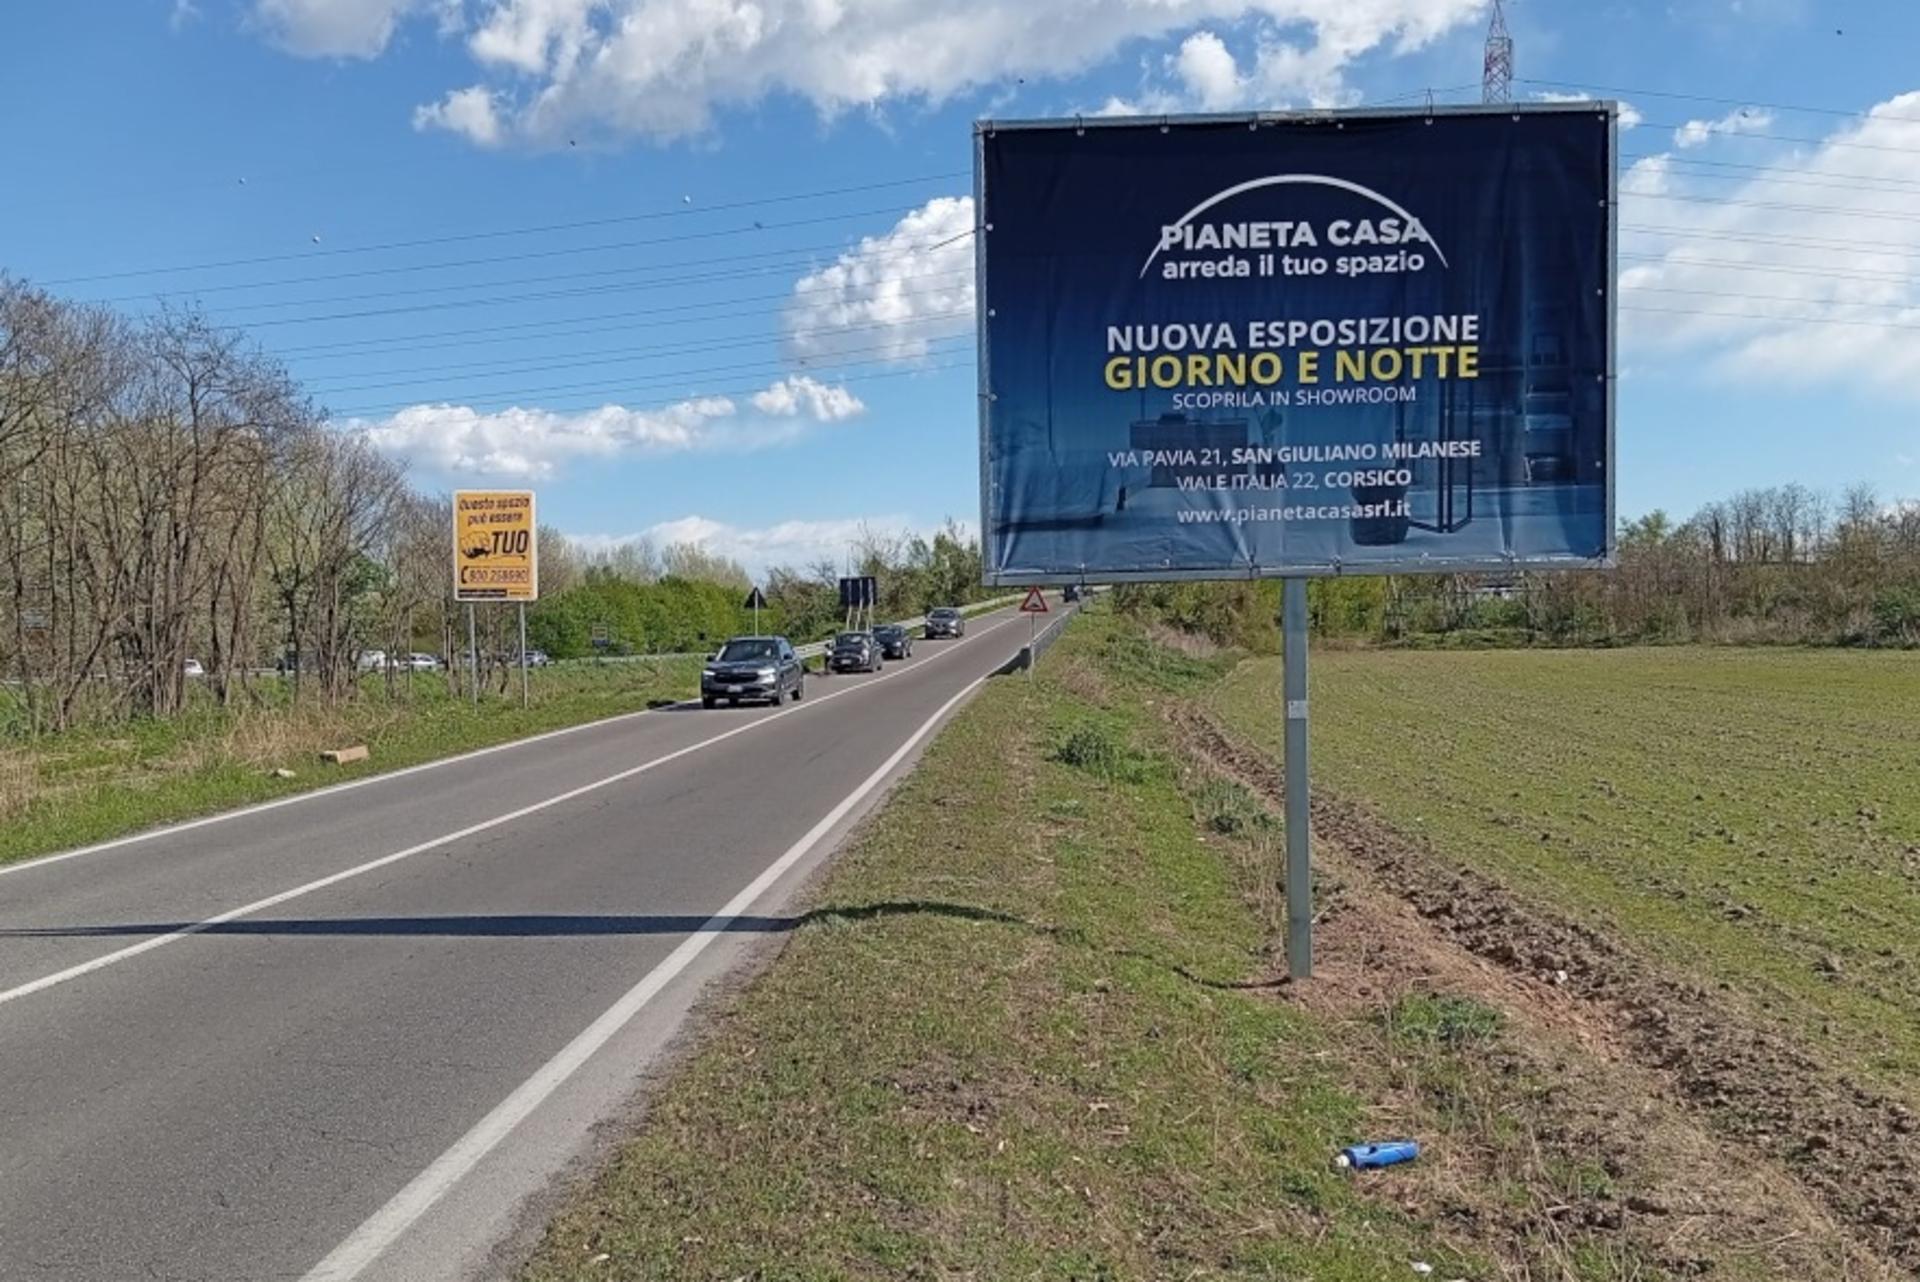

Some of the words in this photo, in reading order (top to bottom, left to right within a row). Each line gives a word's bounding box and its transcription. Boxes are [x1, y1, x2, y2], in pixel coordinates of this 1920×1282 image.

[1160, 221, 1318, 251] PIANETA
[1327, 217, 1430, 247] CASA
[1162, 255, 1250, 280] arreda
[1259, 254, 1274, 277] il
[1282, 255, 1328, 276] tuo
[1335, 250, 1425, 278] spazio
[1107, 323, 1238, 353] NUOVA
[1249, 314, 1480, 349] ESPOSIZIONE
[1104, 351, 1283, 390] GIORNO
[1298, 351, 1320, 384] E
[1335, 345, 1480, 382] NOTTE
[1172, 390, 1265, 410] SCOPRILA
[1270, 389, 1290, 407] IN
[1294, 386, 1417, 407] SHOWROOM
[1107, 451, 1140, 468] VIA
[1142, 449, 1196, 468] PAVIA
[1200, 447, 1228, 467] 21,
[1231, 447, 1276, 465] SAN
[1277, 443, 1377, 464] GIULIANO
[1382, 440, 1482, 460] MILANESE
[1176, 475, 1227, 492] VIALE
[1231, 473, 1288, 491] ITALIA
[1292, 472, 1319, 490] 22,
[1324, 469, 1412, 488] CORSICO
[459, 498, 495, 512] Questo
[496, 498, 530, 511] spazio
[489, 512, 523, 523] essere
[1177, 500, 1412, 525] www.pianetacasasrl.it
[491, 530, 529, 554] TUO
